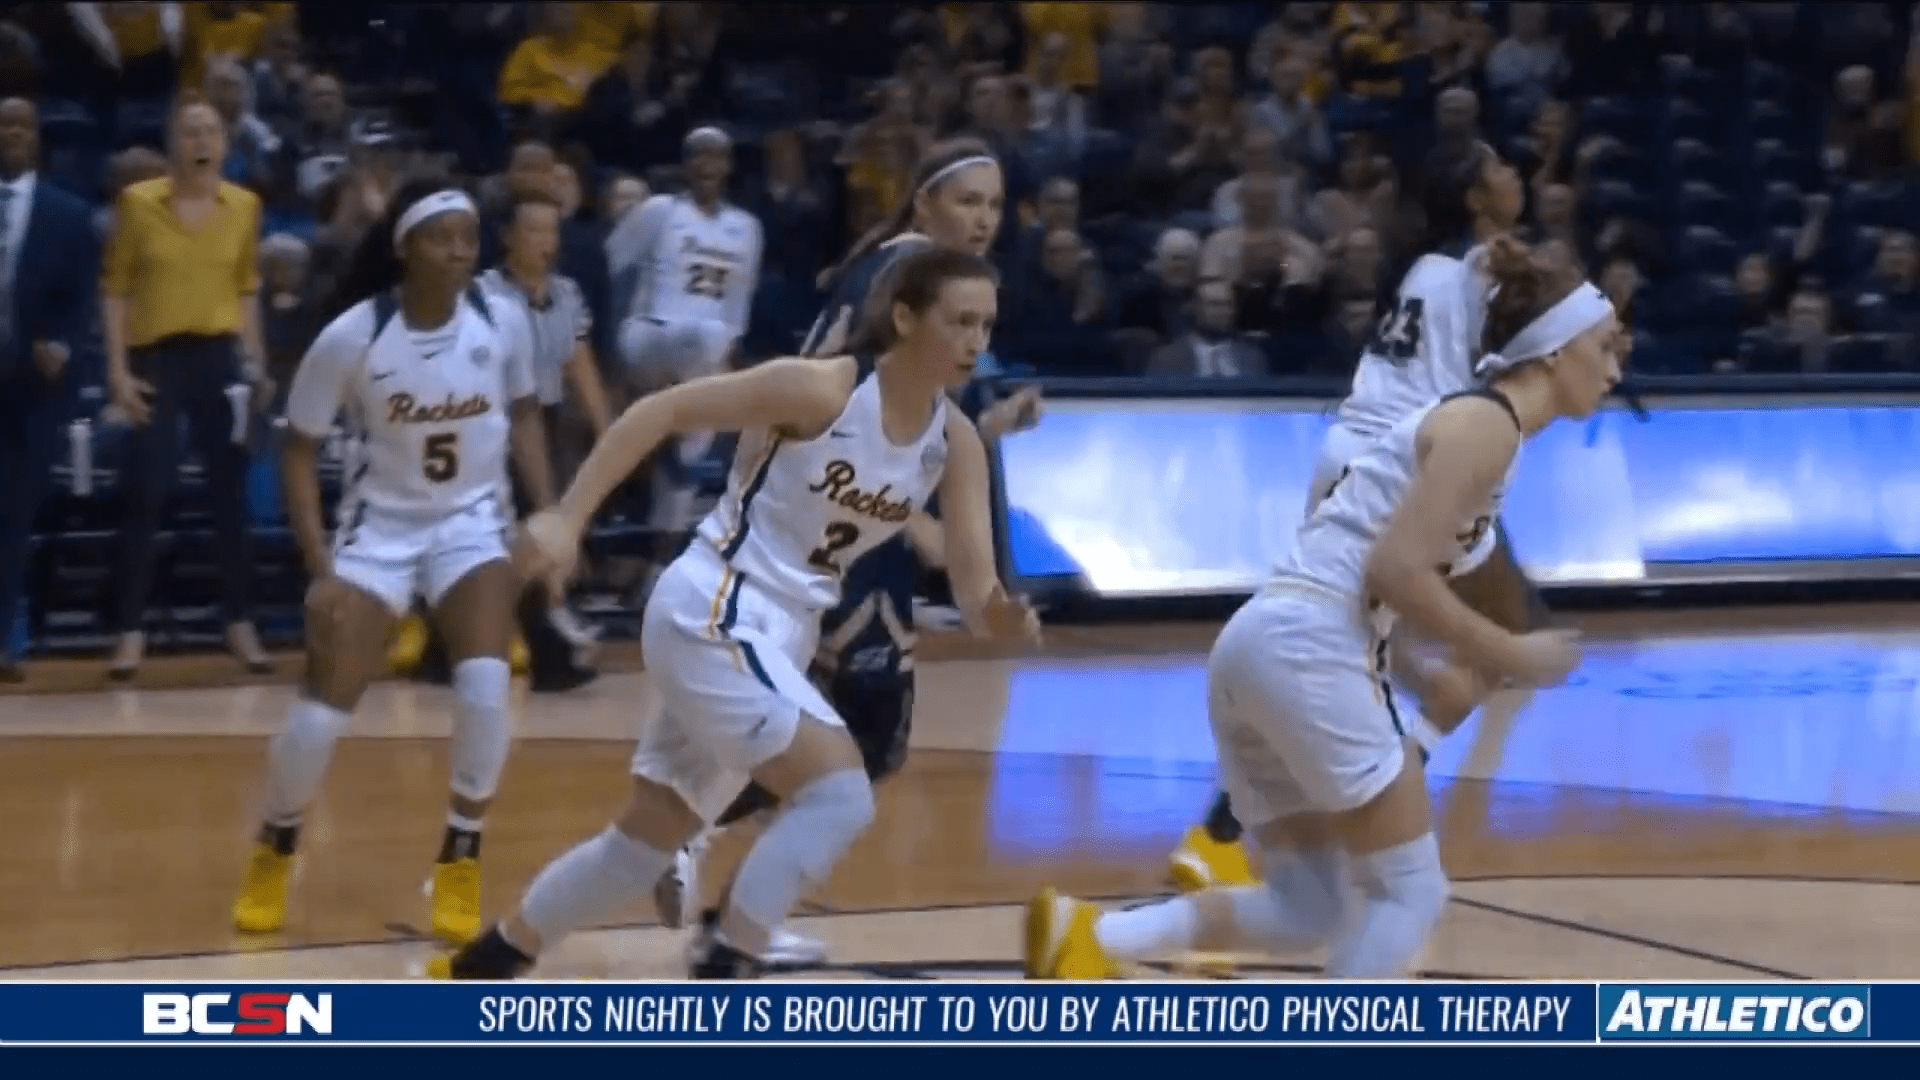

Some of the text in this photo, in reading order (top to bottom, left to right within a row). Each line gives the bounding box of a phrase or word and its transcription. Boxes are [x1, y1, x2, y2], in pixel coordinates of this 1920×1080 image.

[387, 391, 491, 423] Rockets
[424, 433, 458, 482] 5
[808, 522, 859, 573] 2
